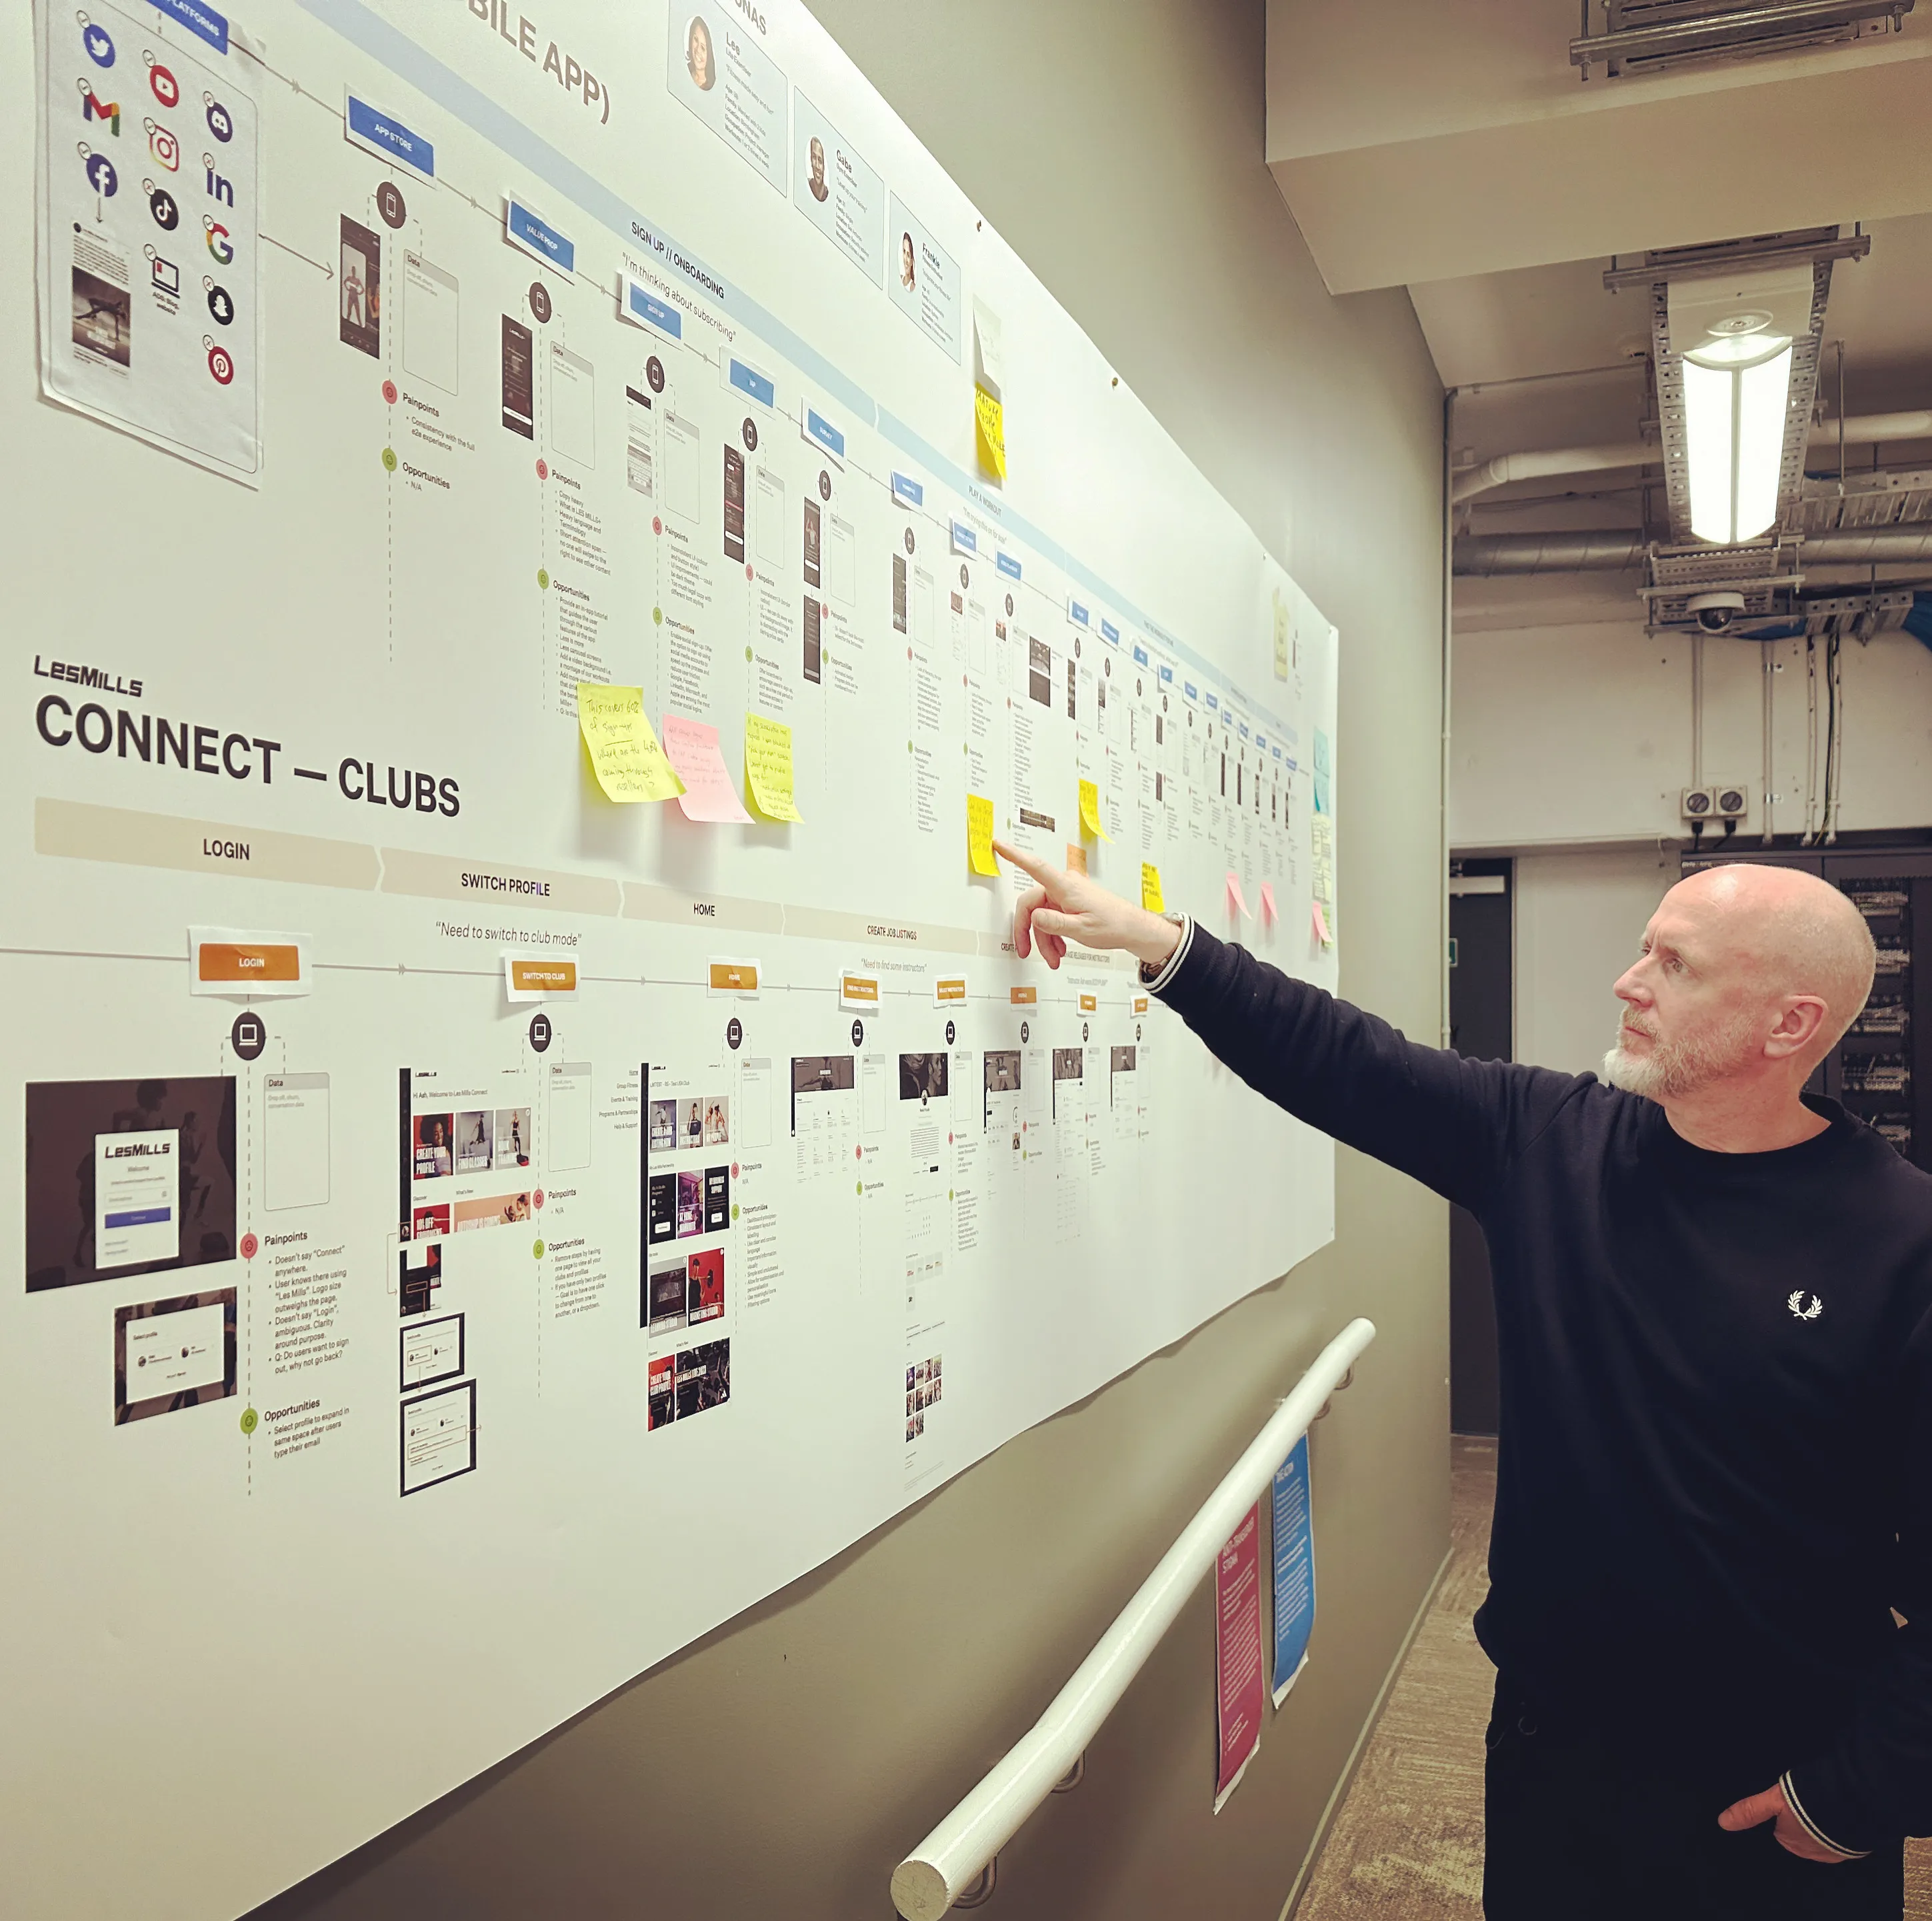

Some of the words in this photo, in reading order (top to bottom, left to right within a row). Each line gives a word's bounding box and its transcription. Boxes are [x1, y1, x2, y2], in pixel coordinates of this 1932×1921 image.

[167, 0, 219, 36] LATFORMS
[726, 32, 739, 55] Lee
[543, 41, 609, 125] APP)
[375, 124, 389, 137] APP
[389, 131, 413, 152] STORE
[527, 224, 545, 241] VALUE
[544, 237, 557, 250] PROP
[407, 255, 420, 267] Data
[632, 221, 651, 246] SIGN
[653, 237, 664, 253] UP
[674, 253, 724, 299] ONBOARDING
[639, 266, 670, 297] thinking
[671, 291, 692, 311] about
[693, 306, 735, 342] subscribing"
[403, 393, 439, 417] Painpoints
[412, 417, 445, 439] Consistency
[445, 433, 457, 443] with
[423, 433, 452, 451] experience
[403, 463, 450, 489] Opportunities
[411, 481, 422, 491] N/A
[552, 469, 581, 490] Painpoints
[553, 580, 590, 601] Opportunities
[665, 617, 695, 635] Opportunities
[586, 699, 602, 715] This
[36, 695, 281, 784] CONNECT
[339, 758, 460, 817] CLUBS
[203, 839, 250, 861] LOGIN
[461, 873, 507, 892] SWITCH
[509, 879, 551, 897] PROFILE
[693, 903, 715, 917] HOME
[472, 925, 483, 939] to
[485, 927, 517, 942] switch
[520, 929, 529, 942] to
[531, 929, 551, 944] club
[867, 925, 886, 936] CREATE
[887, 929, 896, 937] JOB
[896, 929, 917, 941] LISTINGS
[239, 957, 265, 968] LOGIN
[876, 960, 880, 969] to
[890, 962, 902, 971] some
[549, 1188, 576, 1200] Painpoints
[265, 1232, 308, 1246] Painpoints
[549, 1237, 585, 1252] Opportunities
[301, 1252, 312, 1261] say
[275, 1265, 307, 1276] anywhere.
[275, 1280, 290, 1288] User
[292, 1275, 311, 1285] knows
[331, 1269, 347, 1278] using
[312, 1284, 328, 1294] Logo
[275, 1300, 308, 1313] outweighs
[320, 1294, 337, 1305] page.
[275, 1323, 312, 1337] ambiguous.
[313, 1319, 333, 1329] Clarity
[275, 1336, 298, 1350] around
[299, 1332, 326, 1345] purpose.
[275, 1352, 283, 1362] Q:
[284, 1350, 293, 1360] Do
[294, 1346, 311, 1358] users
[313, 1342, 328, 1353] want
[336, 1338, 349, 1348] sign
[275, 1364, 287, 1374] out,
[289, 1359, 301, 1371] why
[303, 1358, 313, 1366] not
[315, 1356, 323, 1366] go
[324, 1350, 343, 1362] back?
[265, 1399, 320, 1422] Opportunities
[274, 1422, 293, 1434] Select
[295, 1417, 313, 1431] profile
[322, 1408, 343, 1422] expand
[274, 1434, 291, 1446] same
[292, 1428, 309, 1441] space
[311, 1425, 325, 1436] after
[326, 1420, 341, 1431] users
[274, 1447, 288, 1459] type
[289, 1441, 303, 1454] their
[305, 1437, 321, 1449] email
